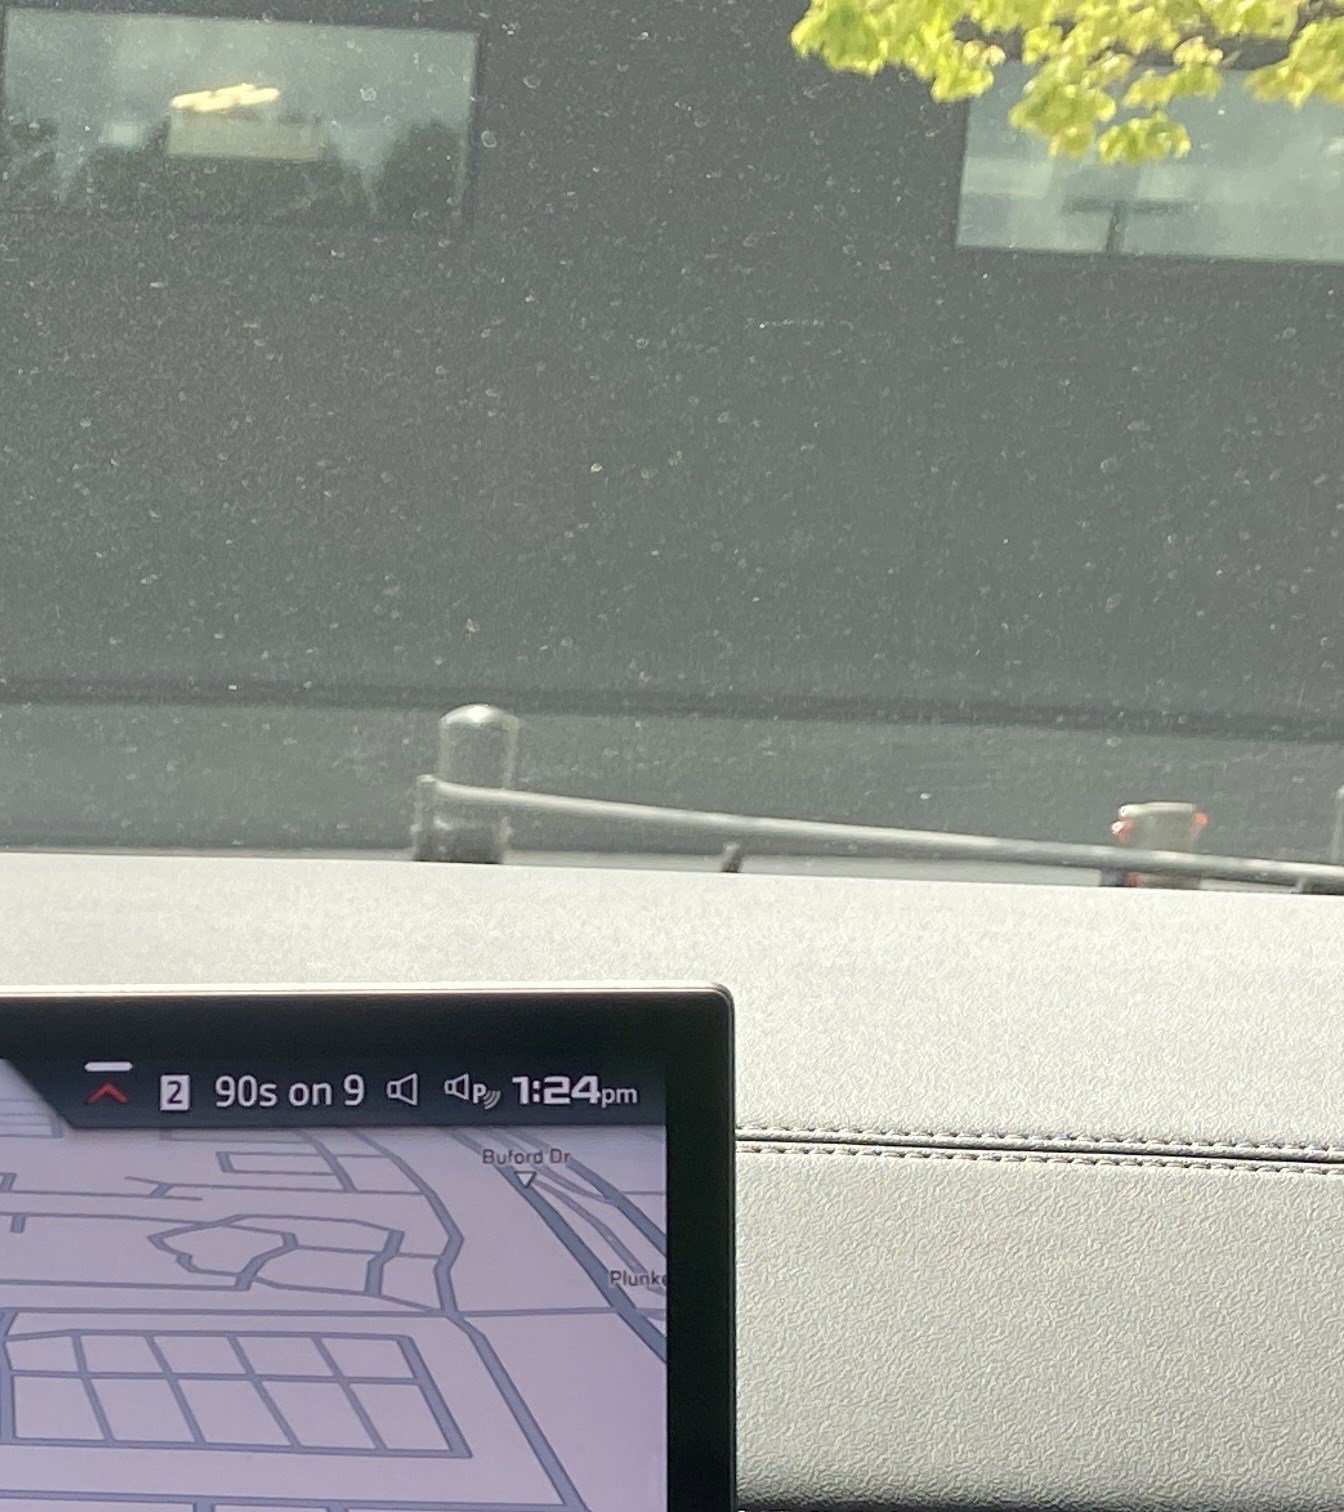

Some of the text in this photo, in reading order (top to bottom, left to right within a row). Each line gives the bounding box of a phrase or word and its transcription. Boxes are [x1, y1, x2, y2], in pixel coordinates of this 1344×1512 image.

[215, 1073, 365, 1107] 90s on 9
[482, 1148, 572, 1165] Buford Dr
